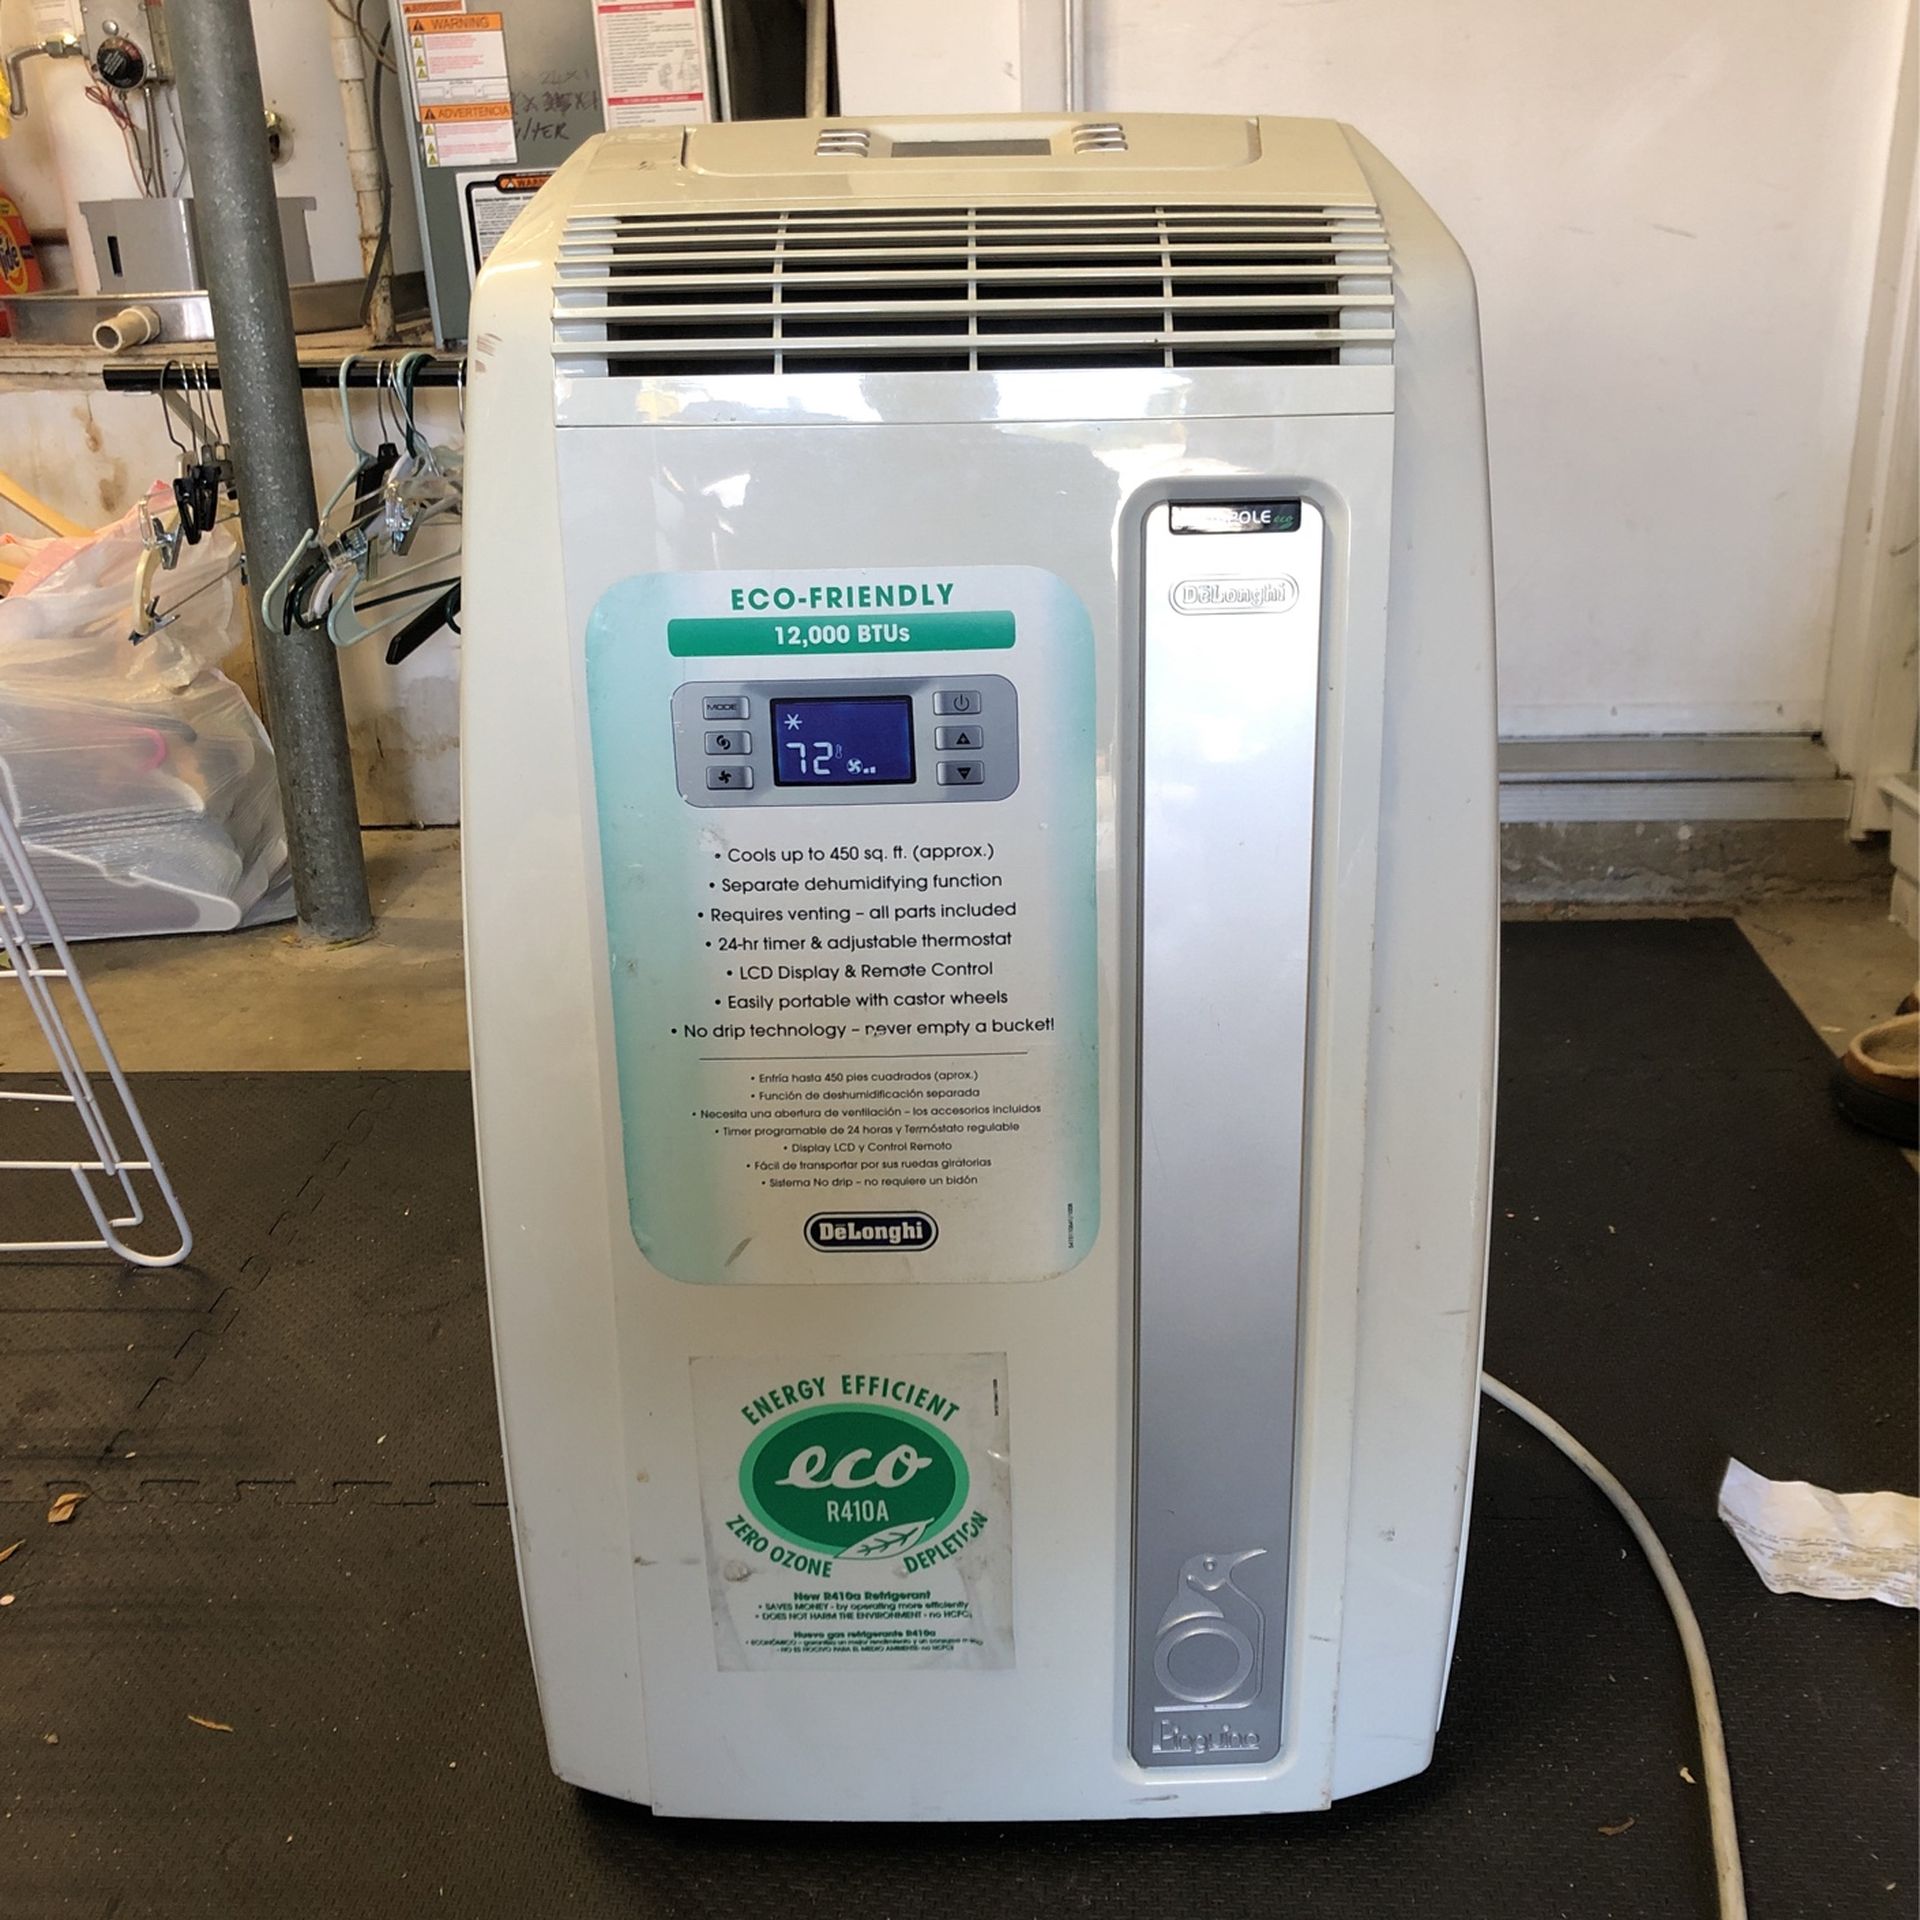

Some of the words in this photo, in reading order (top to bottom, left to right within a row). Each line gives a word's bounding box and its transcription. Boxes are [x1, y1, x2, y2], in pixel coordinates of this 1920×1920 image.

[431, 16, 490, 31] WARNING
[438, 105, 509, 119] ADVERTENCIA
[731, 583, 954, 611] ECO-FRIENDLY
[774, 625, 850, 647] 12,000
[857, 624, 910, 643] BTUs
[706, 703, 738, 712] MODE
[786, 741, 834, 775] 72
[727, 847, 776, 863] Cools
[780, 849, 804, 864] up
[807, 846, 825, 861] to
[829, 845, 859, 861] 450
[863, 848, 888, 863] sq.
[892, 844, 907, 859] ft.
[912, 842, 994, 862] (approx.)
[721, 877, 800, 895] Separate
[804, 874, 928, 892] dehumidifying
[932, 872, 1002, 888] function
[710, 907, 784, 924] Requires
[787, 906, 851, 924] venting
[868, 904, 889, 919] all
[894, 903, 936, 922] parts
[940, 901, 1016, 918] included
[718, 936, 759, 951] 24-hr
[762, 936, 806, 950] timer
[810, 935, 823, 950] &
[826, 934, 917, 952] adjustable
[921, 931, 1012, 947] thermostat
[739, 965, 773, 980] LCD
[778, 965, 840, 982] Display
[844, 963, 857, 978] &
[860, 963, 926, 978] Remote
[931, 961, 993, 977] Control
[727, 994, 774, 1012] Easily
[778, 993, 851, 1011] portable
[855, 992, 889, 1007] with
[893, 991, 946, 1006] castor
[949, 989, 1008, 1005] wheels
[684, 1024, 708, 1038] No
[712, 1023, 746, 1040] drip
[749, 1022, 846, 1040] technology
[864, 1023, 912, 1038] never
[916, 1019, 971, 1037] empty
[974, 1021, 987, 1033] a
[991, 1017, 1054, 1033] bucket!
[790, 1073, 822, 1083] hasta
[824, 1072, 844, 1082] 450
[845, 1072, 869, 1084] pies
[870, 1071, 932, 1083] cuadrados
[933, 1070, 978, 1083] (aprox.)
[758, 1089, 802, 1101] Función
[804, 1090, 820, 1101] de
[822, 1087, 924, 1100] deshumidificación
[926, 1088, 980, 1101] separada
[700, 1109, 748, 1119] Necesita
[750, 1110, 772, 1119] una
[773, 1108, 822, 1119] abertura
[823, 1108, 839, 1118] de
[841, 1105, 902, 1119] ventilación
[912, 1106, 928, 1116] los
[930, 1105, 990, 1116] accesorios
[992, 1103, 1042, 1117] incluidos
[723, 1126, 752, 1136] Timer
[754, 1125, 827, 1138] programable
[828, 1125, 845, 1135] de
[846, 1124, 860, 1135] 24
[862, 1125, 893, 1135] horas
[895, 1126, 902, 1135] y
[904, 1122, 965, 1134] Termóstato
[966, 1120, 1020, 1135] regulable
[791, 1142, 832, 1155] Display
[833, 1142, 856, 1153] LCD
[857, 1144, 865, 1154] y
[867, 1140, 908, 1152] Control
[909, 1140, 953, 1151] Remoto
[754, 1160, 780, 1171] Fácil
[781, 1160, 798, 1171] de
[799, 1160, 858, 1171] transportar
[860, 1160, 880, 1172] por
[881, 1160, 899, 1169] sus
[900, 1158, 939, 1169] ruedas
[940, 1156, 992, 1170] giratorias
[769, 1178, 811, 1188] Sistema
[812, 1177, 830, 1187] No
[831, 1177, 854, 1188] drip
[863, 1177, 879, 1187] no
[880, 1176, 927, 1188] requiere
[928, 1177, 942, 1186] un
[945, 1174, 978, 1186] bidón
[740, 1376, 826, 1426] ENERGY
[841, 1374, 960, 1422] EFFICIENT
[774, 1443, 933, 1489] eco
[826, 1500, 889, 1522] R410A
[725, 1514, 769, 1553] ZERO
[769, 1545, 833, 1578] OZONE
[903, 1510, 989, 1574] DEPLETION
[793, 1591, 820, 1601] New
[823, 1591, 862, 1601] R410a
[863, 1589, 931, 1602] Refrigerant
[765, 1602, 793, 1611] SAVES
[794, 1602, 829, 1611] MONEY
[836, 1602, 848, 1613] by
[850, 1601, 897, 1613] operating
[898, 1602, 922, 1610] more
[925, 1600, 970, 1612] efficiently
